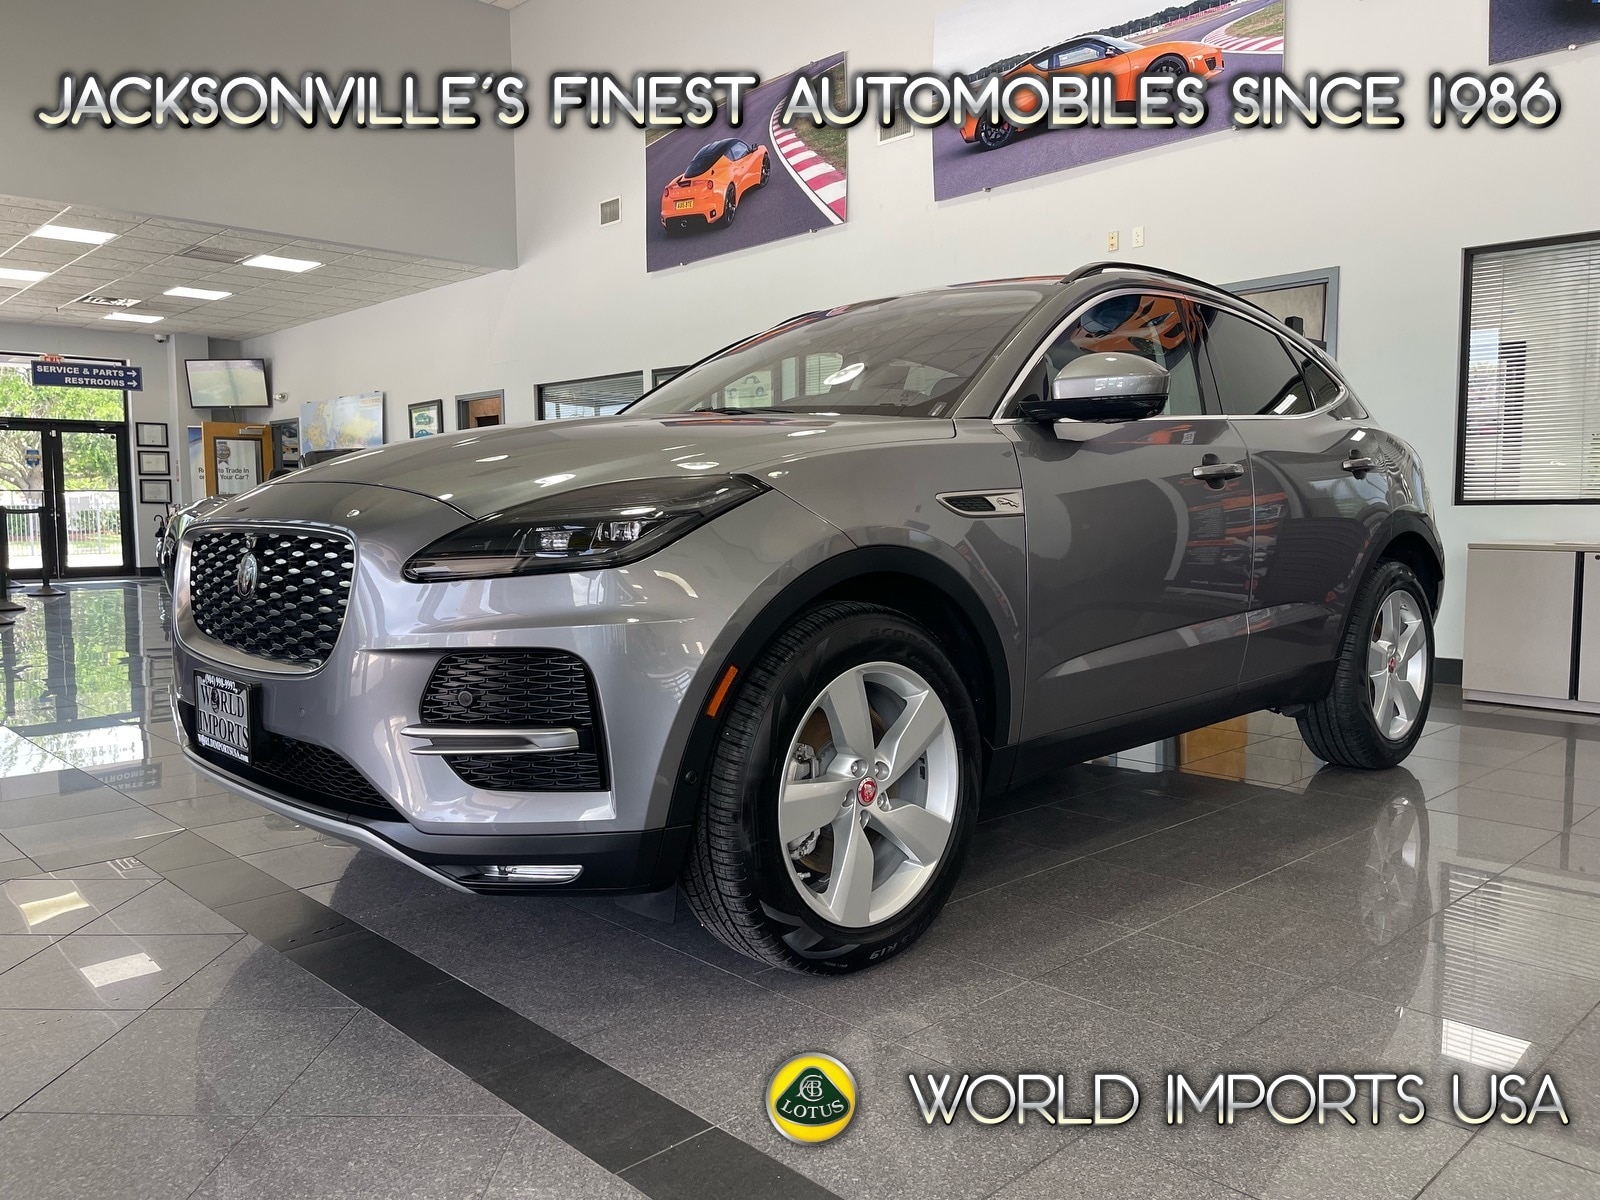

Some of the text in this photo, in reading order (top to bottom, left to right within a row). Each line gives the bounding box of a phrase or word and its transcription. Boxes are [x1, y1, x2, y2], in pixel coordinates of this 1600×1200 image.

[36, 365, 125, 377] SERVICE & PARTS
[64, 377, 125, 387] RESTROOMS
[200, 684, 245, 718] WORLD
[198, 709, 249, 749] IMPORTS
